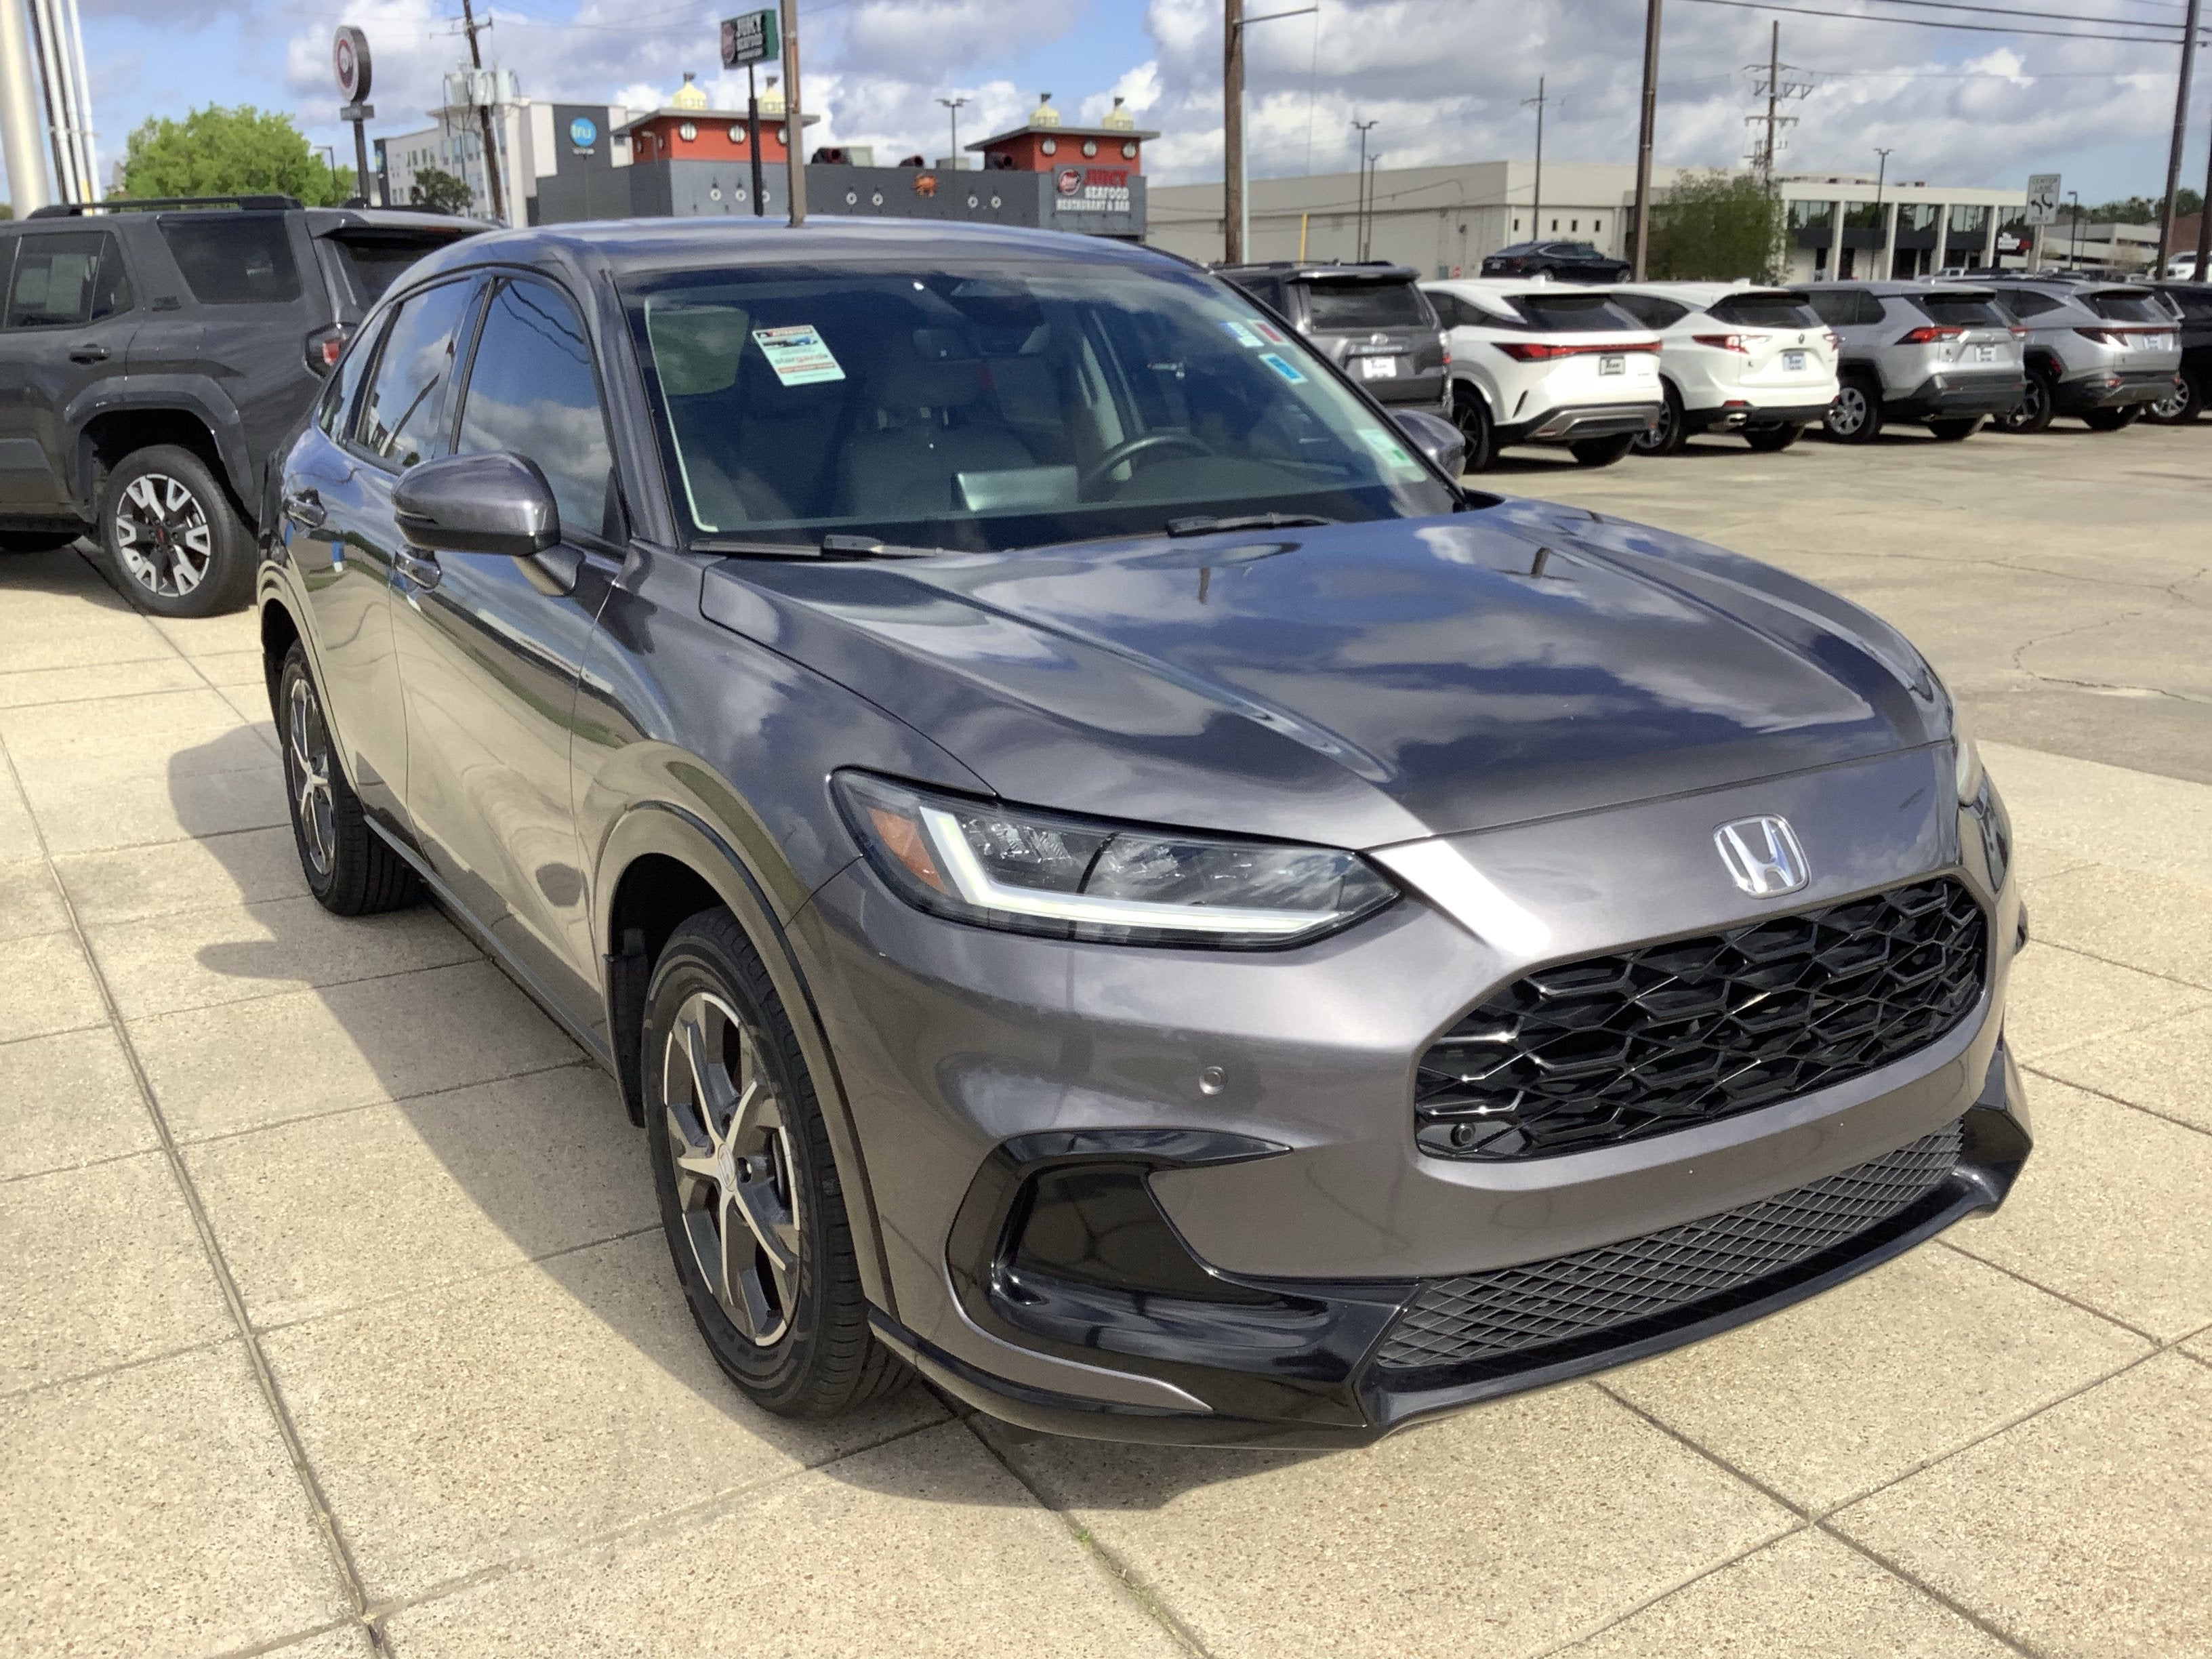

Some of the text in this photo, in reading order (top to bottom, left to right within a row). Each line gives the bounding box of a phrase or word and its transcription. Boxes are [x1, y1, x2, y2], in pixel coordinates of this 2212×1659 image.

[571, 124, 592, 140] tru
[1084, 169, 1128, 187] JUICY
[1084, 186, 1129, 200] SEAFOOD
[1056, 198, 1106, 211] RESTAURANT
[1113, 200, 1130, 212] BAR
